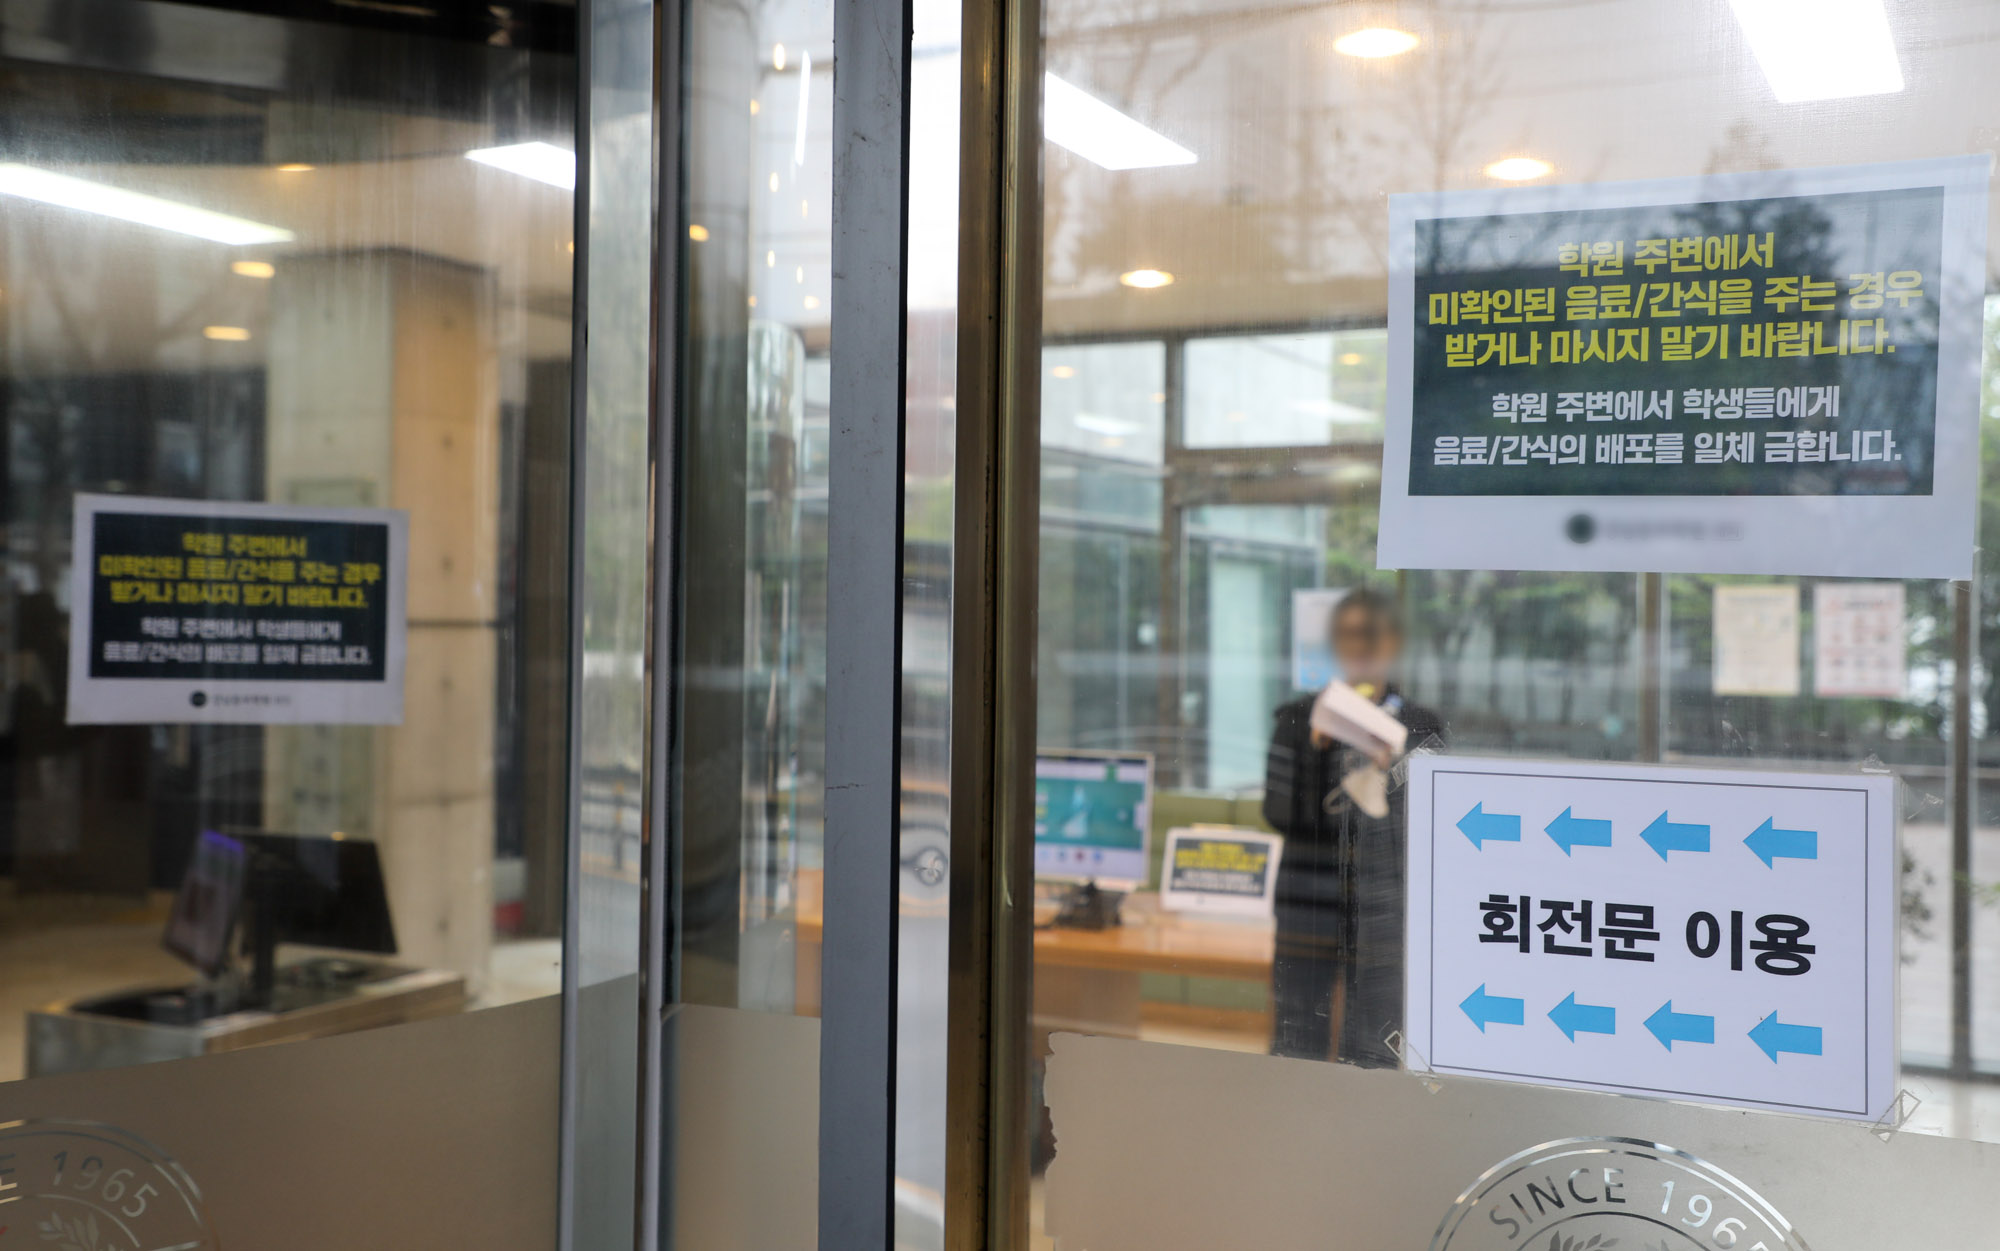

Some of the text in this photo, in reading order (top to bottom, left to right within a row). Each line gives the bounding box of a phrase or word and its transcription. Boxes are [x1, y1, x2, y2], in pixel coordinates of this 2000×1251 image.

[1559, 232, 1775, 277] 학원 주변에서
[1428, 269, 1924, 326] 미확인된 음료/간식을 주는 경우
[1445, 317, 1897, 368] 받거나 마시지 말기 바랍니다.
[1492, 385, 1840, 424] 학원 주변에서 학생들에게
[1433, 429, 1903, 466] 음료/간식의 배포를 일체 금합니다.
[1478, 893, 1817, 977] 회전문 이용
[52, 1151, 159, 1218] 1965
[1488, 1167, 1627, 1241] SINCE
